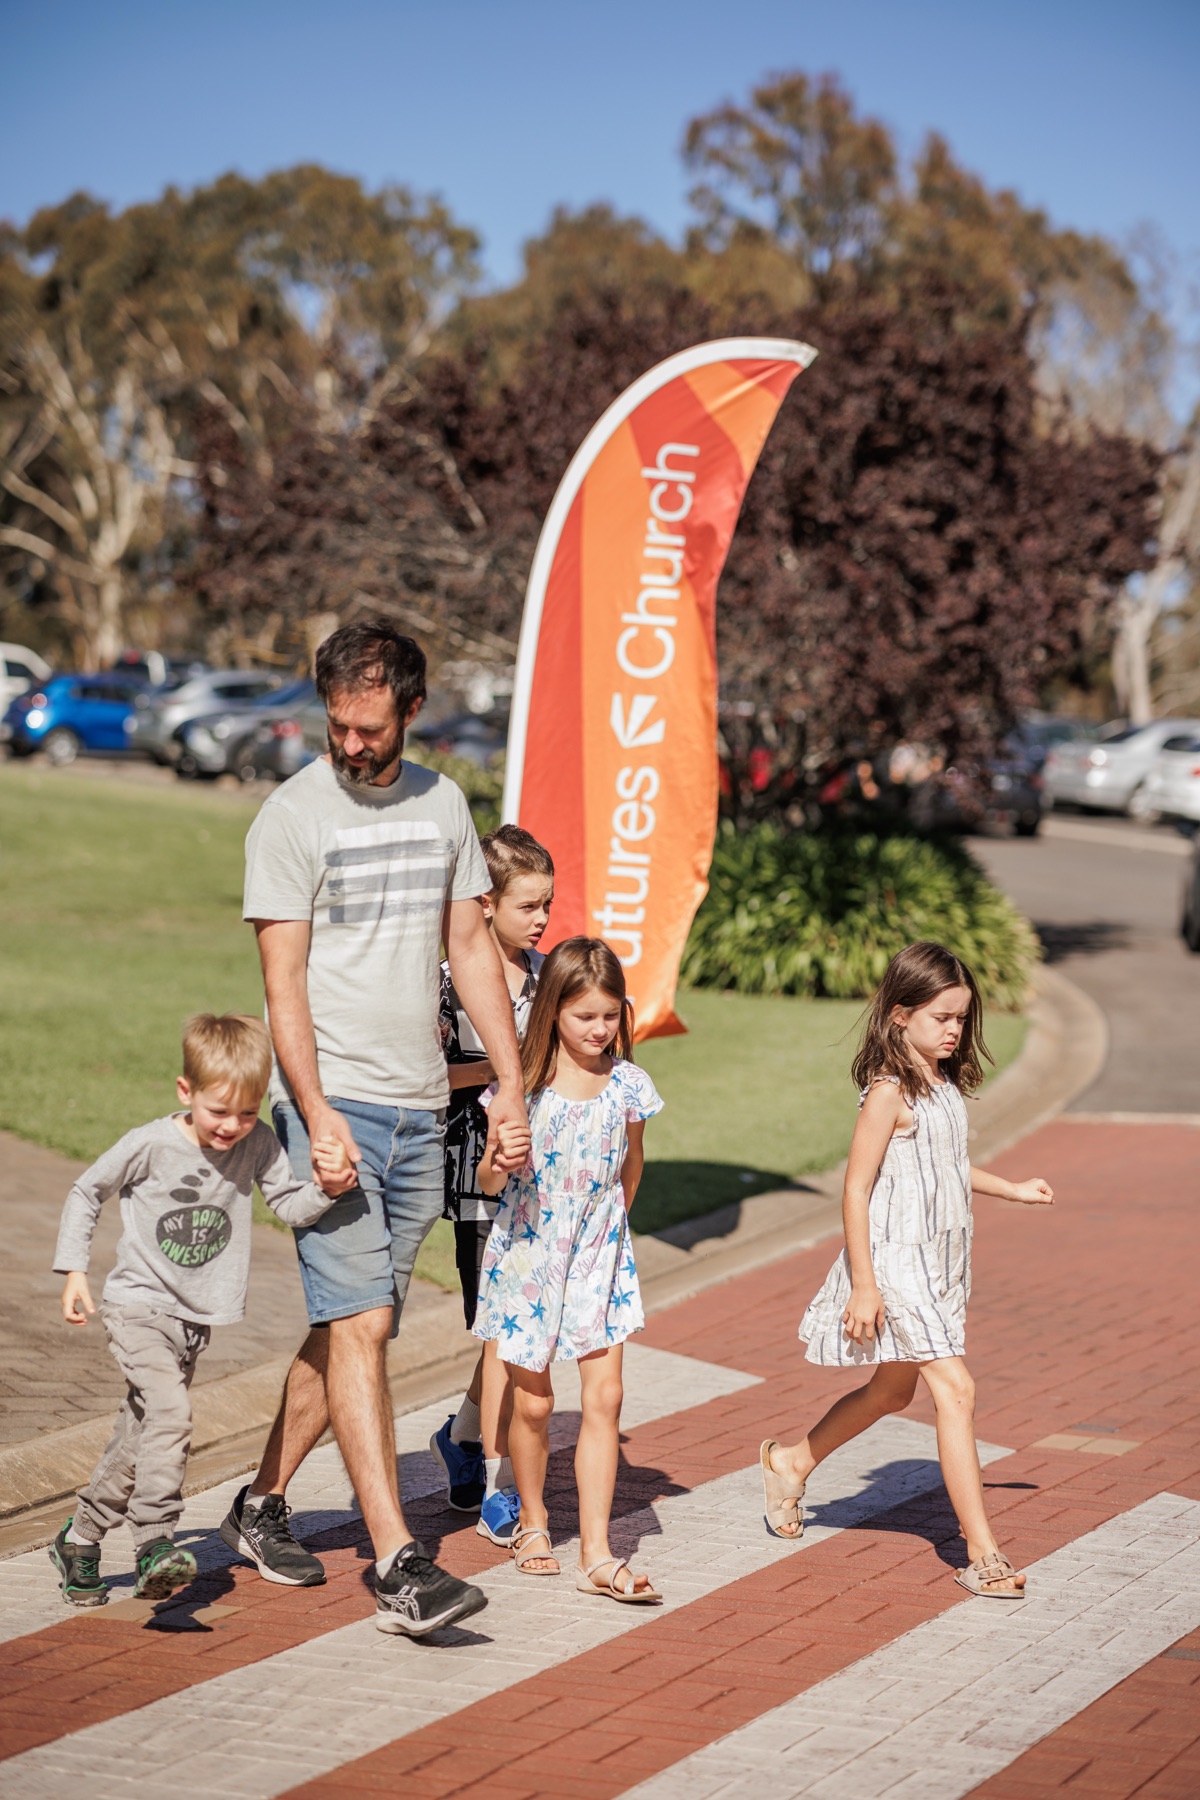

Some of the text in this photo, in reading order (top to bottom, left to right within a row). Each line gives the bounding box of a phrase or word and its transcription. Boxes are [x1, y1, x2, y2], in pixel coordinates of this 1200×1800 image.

[592, 441, 700, 1004] utures Church
[163, 1214, 184, 1233] MY
[190, 1229, 209, 1245] IS
[161, 1236, 226, 1265] AWESOME
